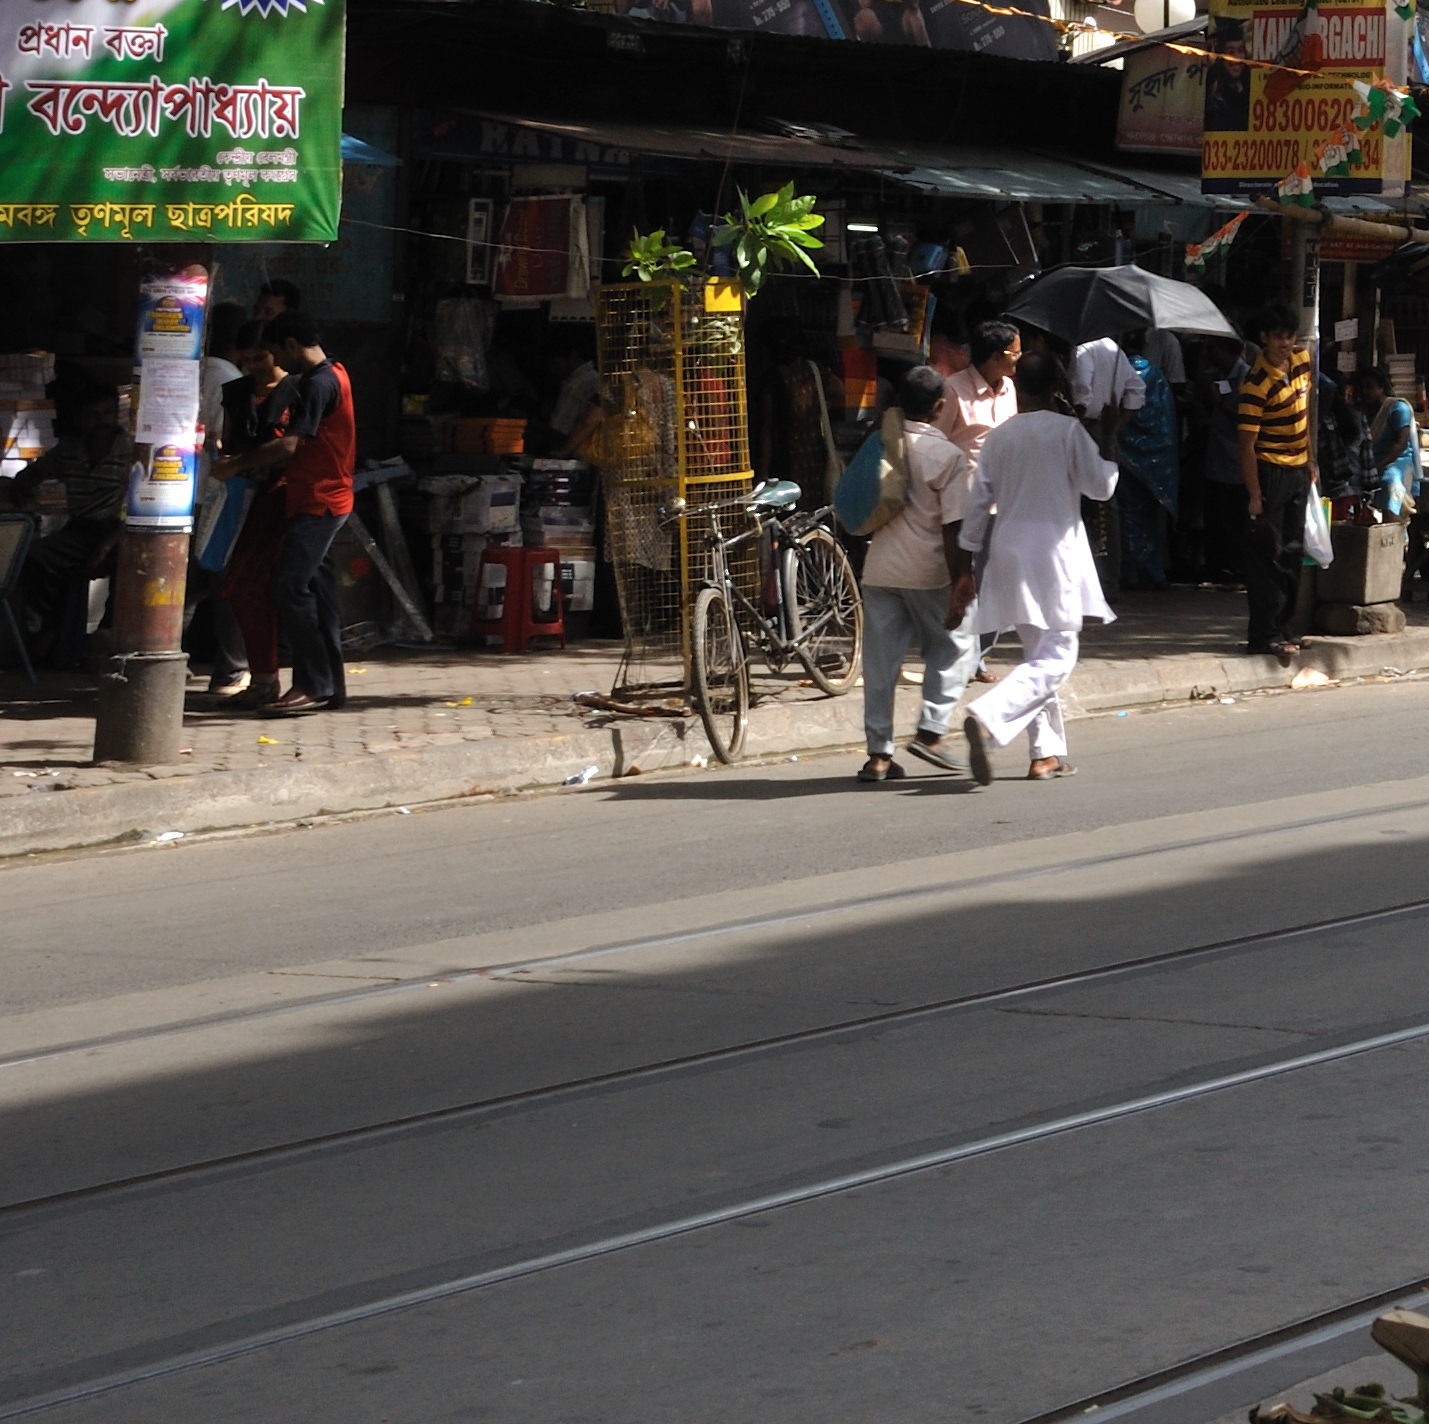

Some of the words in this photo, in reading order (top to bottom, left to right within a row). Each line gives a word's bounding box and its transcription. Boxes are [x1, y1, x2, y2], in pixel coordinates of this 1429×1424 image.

[17, 20, 96, 58] প্রধান
[103, 22, 168, 63] বক্তা
[1253, 14, 1386, 62] KANRGACHI
[24, 74, 307, 140] বন্দ্যোপাধ্যায়
[1203, 139, 1300, 171] 033-23200078
[70, 202, 157, 240] তৃণমূল
[165, 192, 296, 230] ছাত্রপরিষদ
